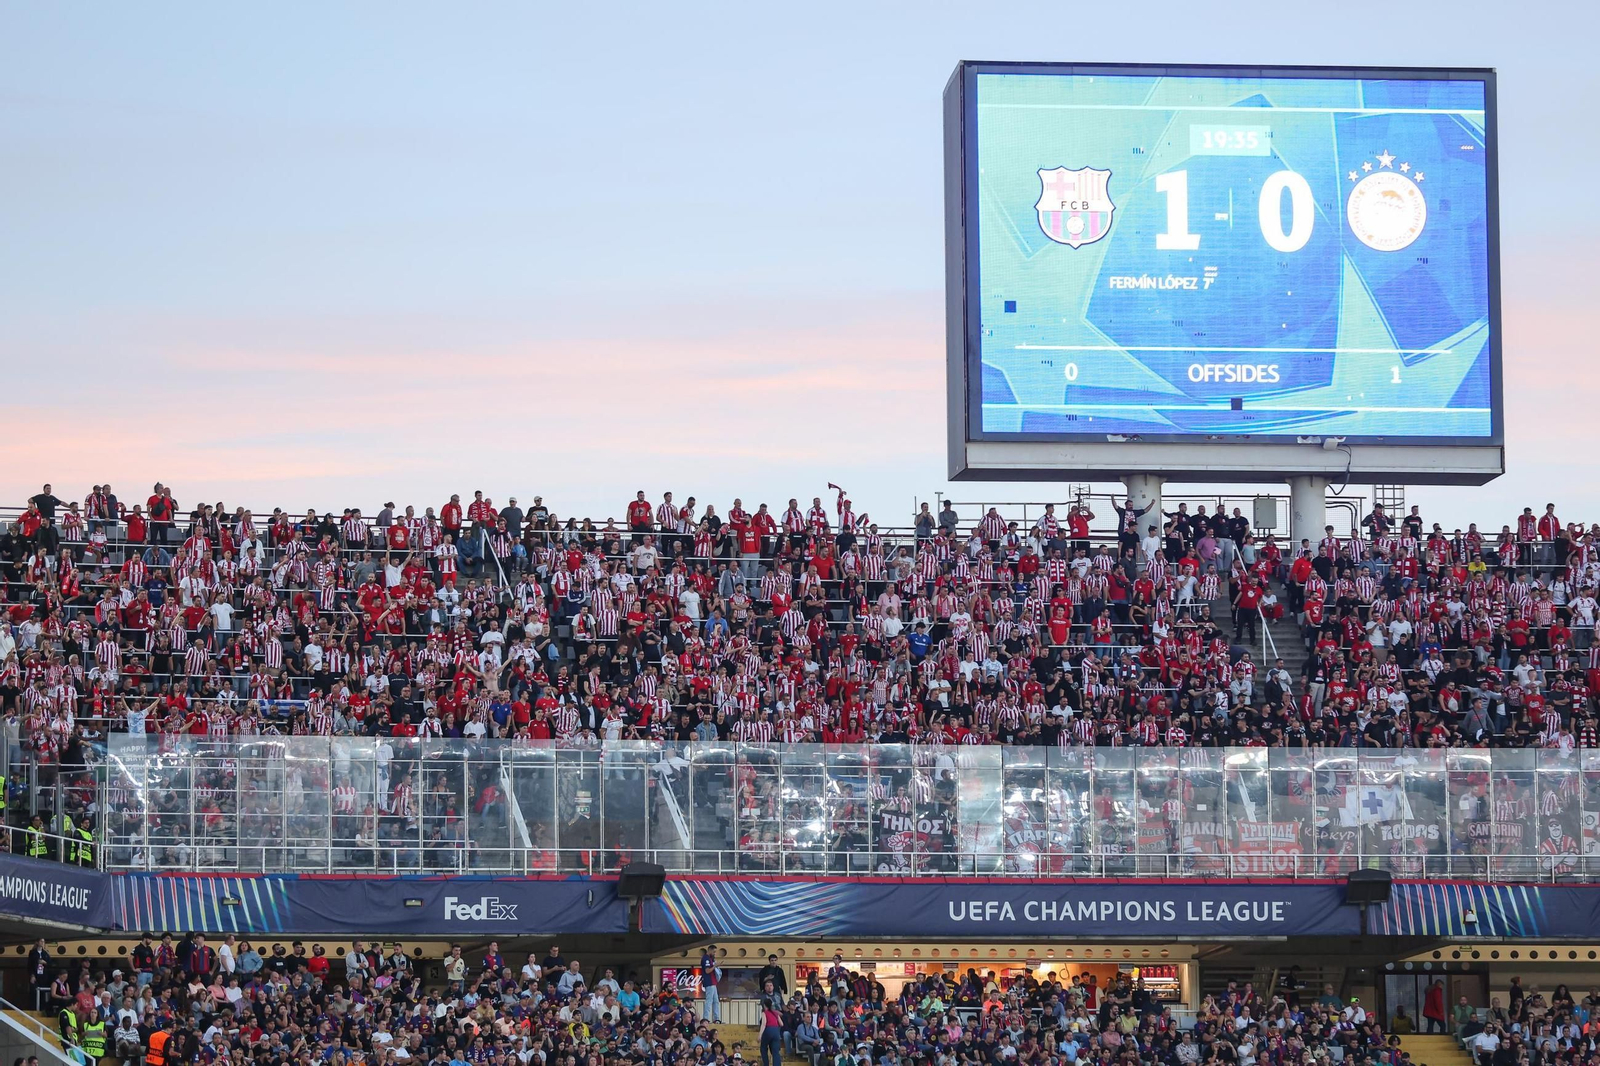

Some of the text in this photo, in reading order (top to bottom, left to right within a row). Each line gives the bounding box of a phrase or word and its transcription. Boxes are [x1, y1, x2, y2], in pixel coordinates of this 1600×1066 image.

[1202, 131, 1259, 149] 19:35
[1061, 200, 1090, 211] FCB
[1155, 169, 1201, 250] 1
[1258, 170, 1315, 253] 0
[1109, 273, 1157, 289] FERMÍN
[1158, 274, 1198, 290] LÓPEZ
[1064, 362, 1079, 381] 0
[1187, 363, 1280, 383] OFFSIDES
[1389, 366, 1402, 384] 1
[120, 745, 146, 753] HAPPY
[49, 883, 89, 910] LEAGUE
[444, 896, 518, 921] FedEx
[949, 901, 1016, 921] UEFA
[1024, 901, 1176, 921] CHAMPIONS
[1187, 901, 1285, 921] LEAGUE
